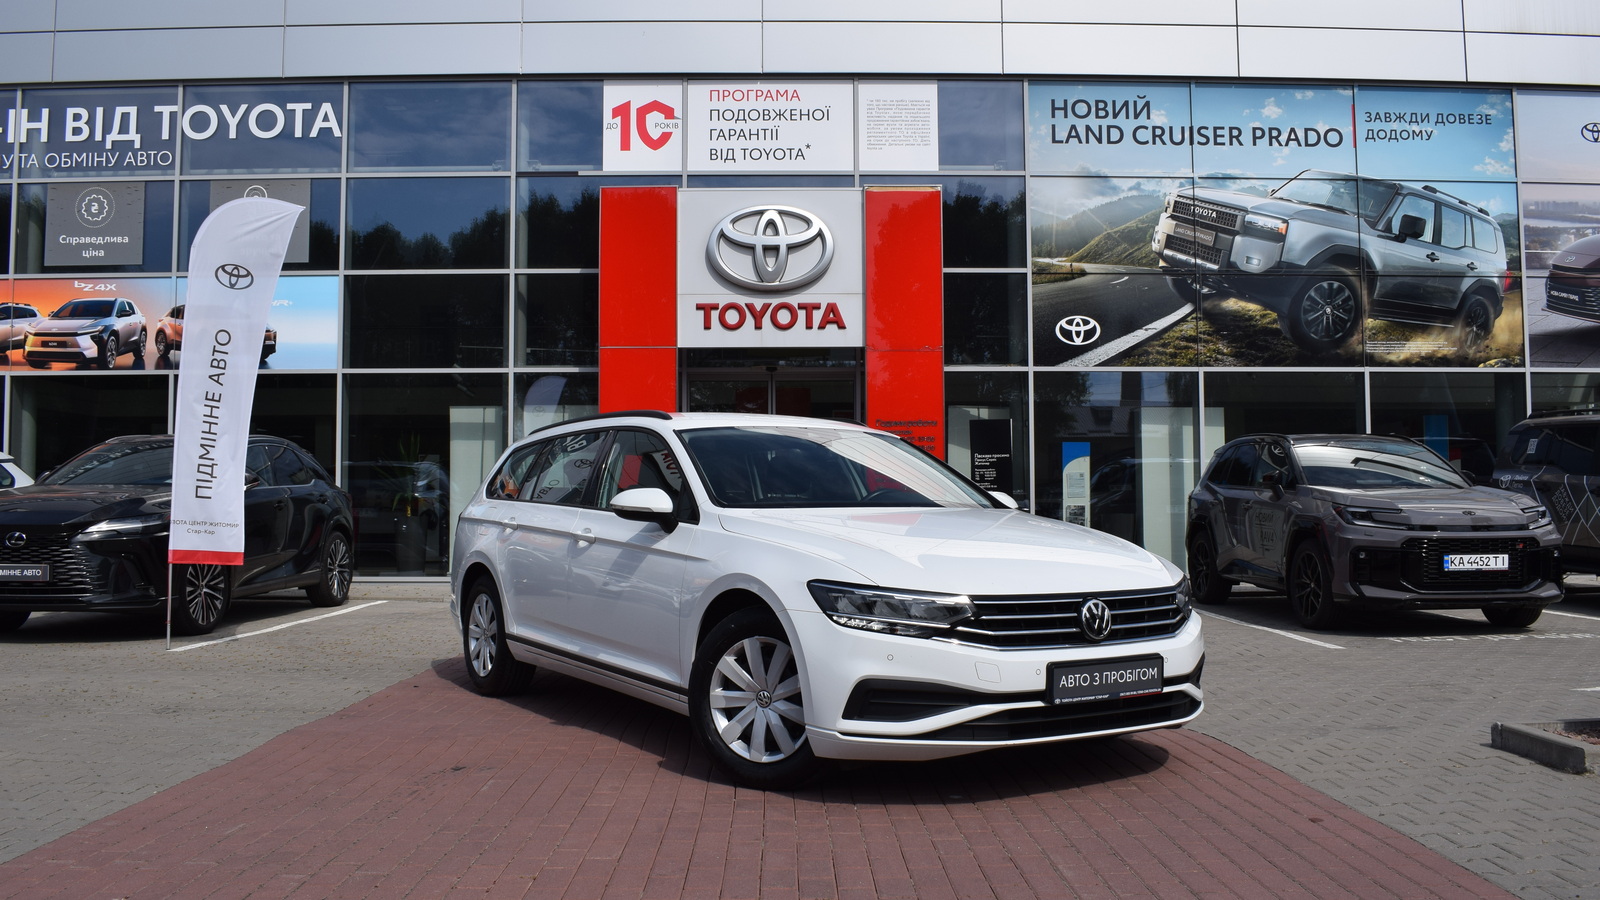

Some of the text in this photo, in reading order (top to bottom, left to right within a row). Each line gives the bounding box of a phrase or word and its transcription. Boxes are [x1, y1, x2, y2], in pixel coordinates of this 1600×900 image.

[709, 89, 801, 102] ПРОГРАМА
[709, 106, 832, 122] ПОДОВЖЕНОЇ
[1050, 95, 1151, 120] НОВИЙ
[65, 106, 142, 150] ВІД
[154, 103, 343, 141] TOYOTA
[654, 122, 679, 130] РОКІВ
[1364, 111, 1493, 126] ЗАВЖДИ ДОВЕЗЕ
[709, 125, 780, 141] ГАРАНТІЇ
[1050, 123, 1344, 148] LAND CRUISER PRADO
[1364, 128, 1435, 142] ДОДОМУ
[18, 153, 39, 168] ТА
[44, 152, 124, 168] ОБМІНУ
[124, 150, 173, 166] АВТО
[709, 147, 736, 163] ВІД
[59, 234, 129, 246] Справедлива
[82, 247, 105, 258] ціна
[695, 301, 847, 331] TOYOTA
[194, 329, 232, 500] ПІДМІННЕ АВТО
[186, 528, 216, 536] Стар-Кар
[188, 520, 208, 528] ЦЕНТР
[208, 521, 240, 529] ЖИТОМИР
[22, 568, 42, 577] АВТО
[1059, 673, 1091, 689] АВТО
[1102, 666, 1158, 685] ПРОБІГОМ
